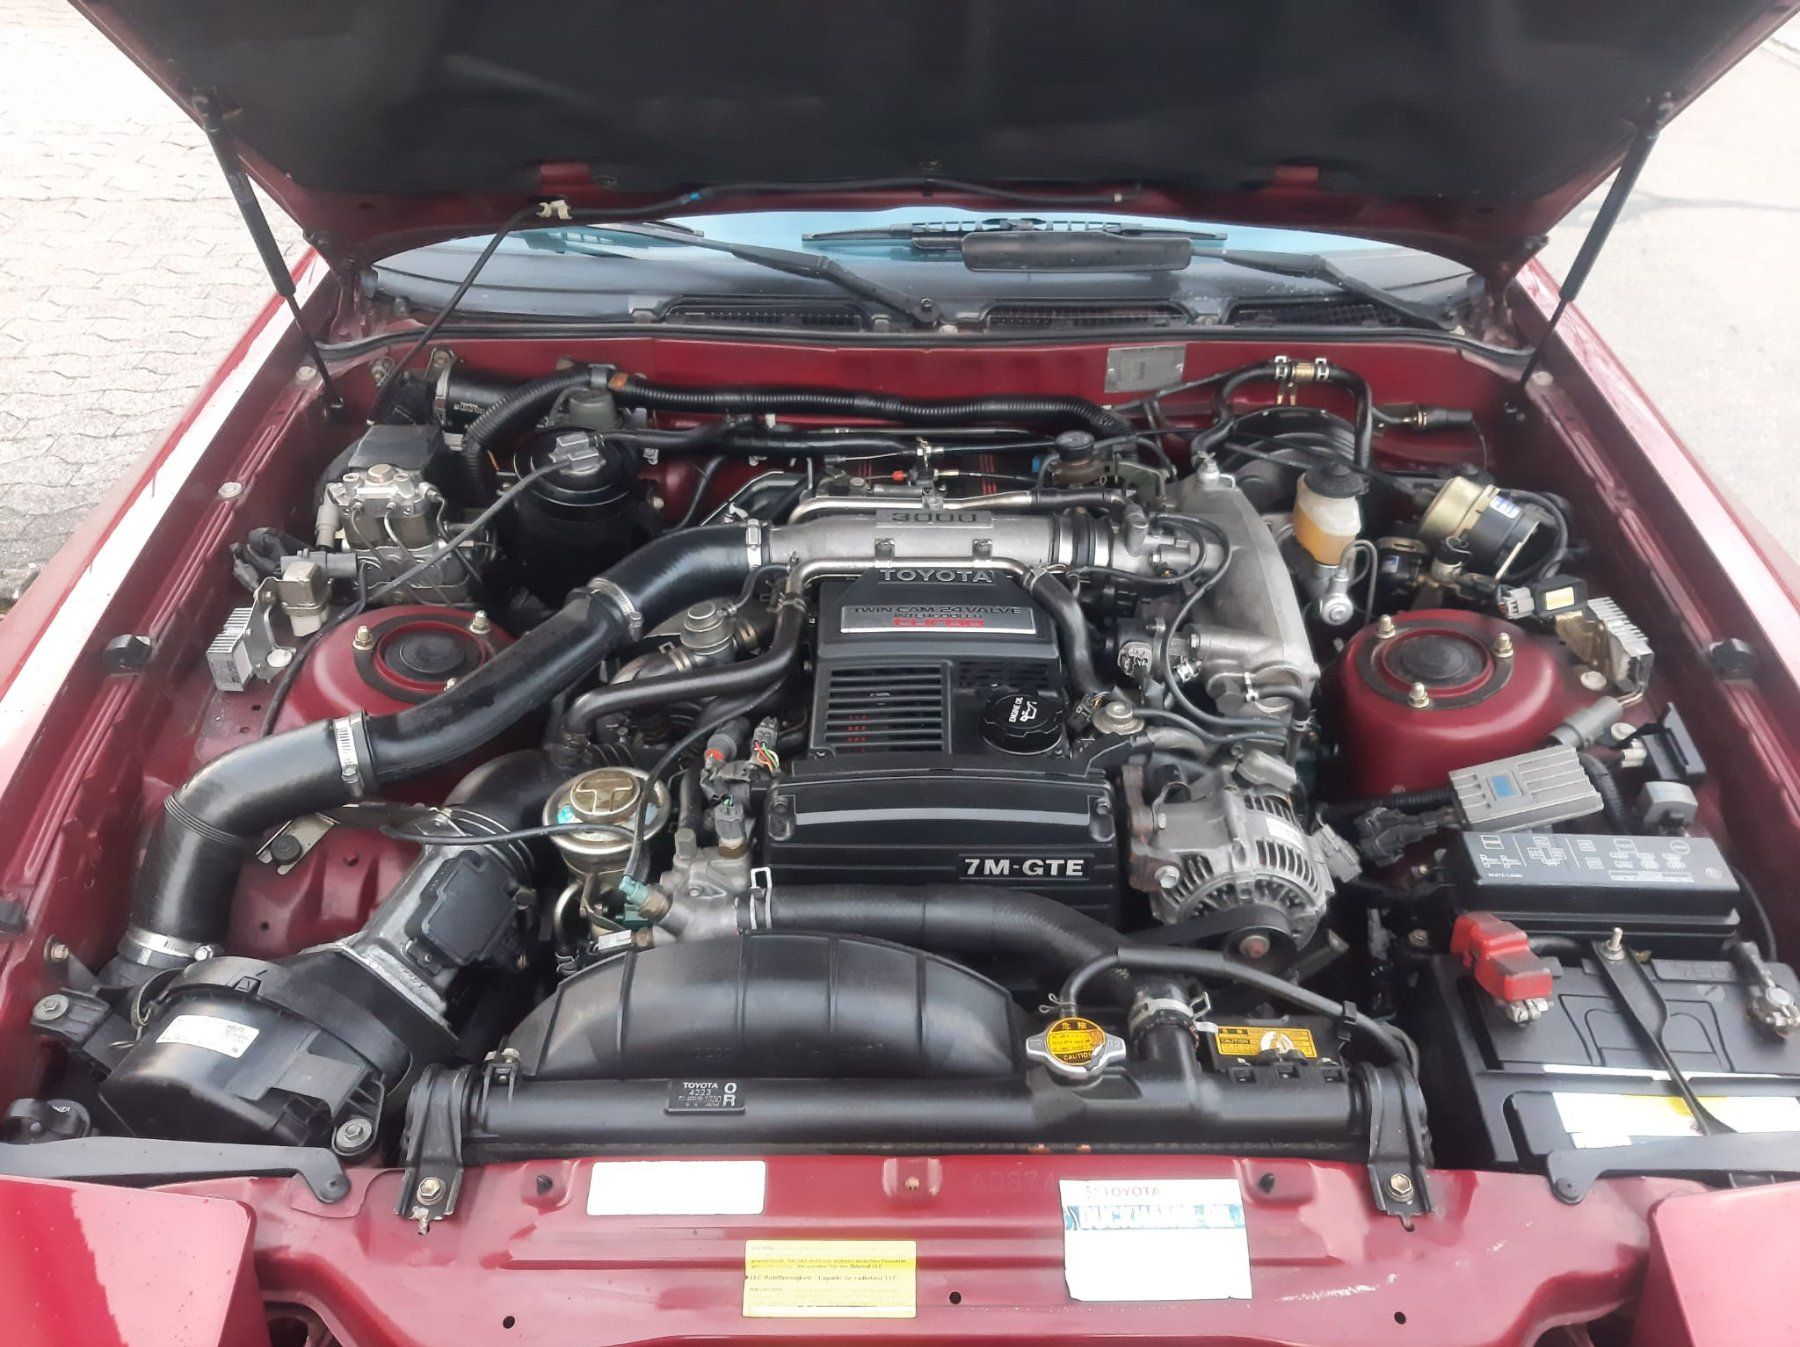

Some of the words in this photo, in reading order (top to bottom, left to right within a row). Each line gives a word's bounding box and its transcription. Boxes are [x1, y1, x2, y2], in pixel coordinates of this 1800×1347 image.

[892, 512, 977, 522] 3000
[879, 568, 993, 583] TOYOTA
[964, 858, 1084, 876] 7M-GTE
[1104, 1186, 1160, 1197] TOYOTA
